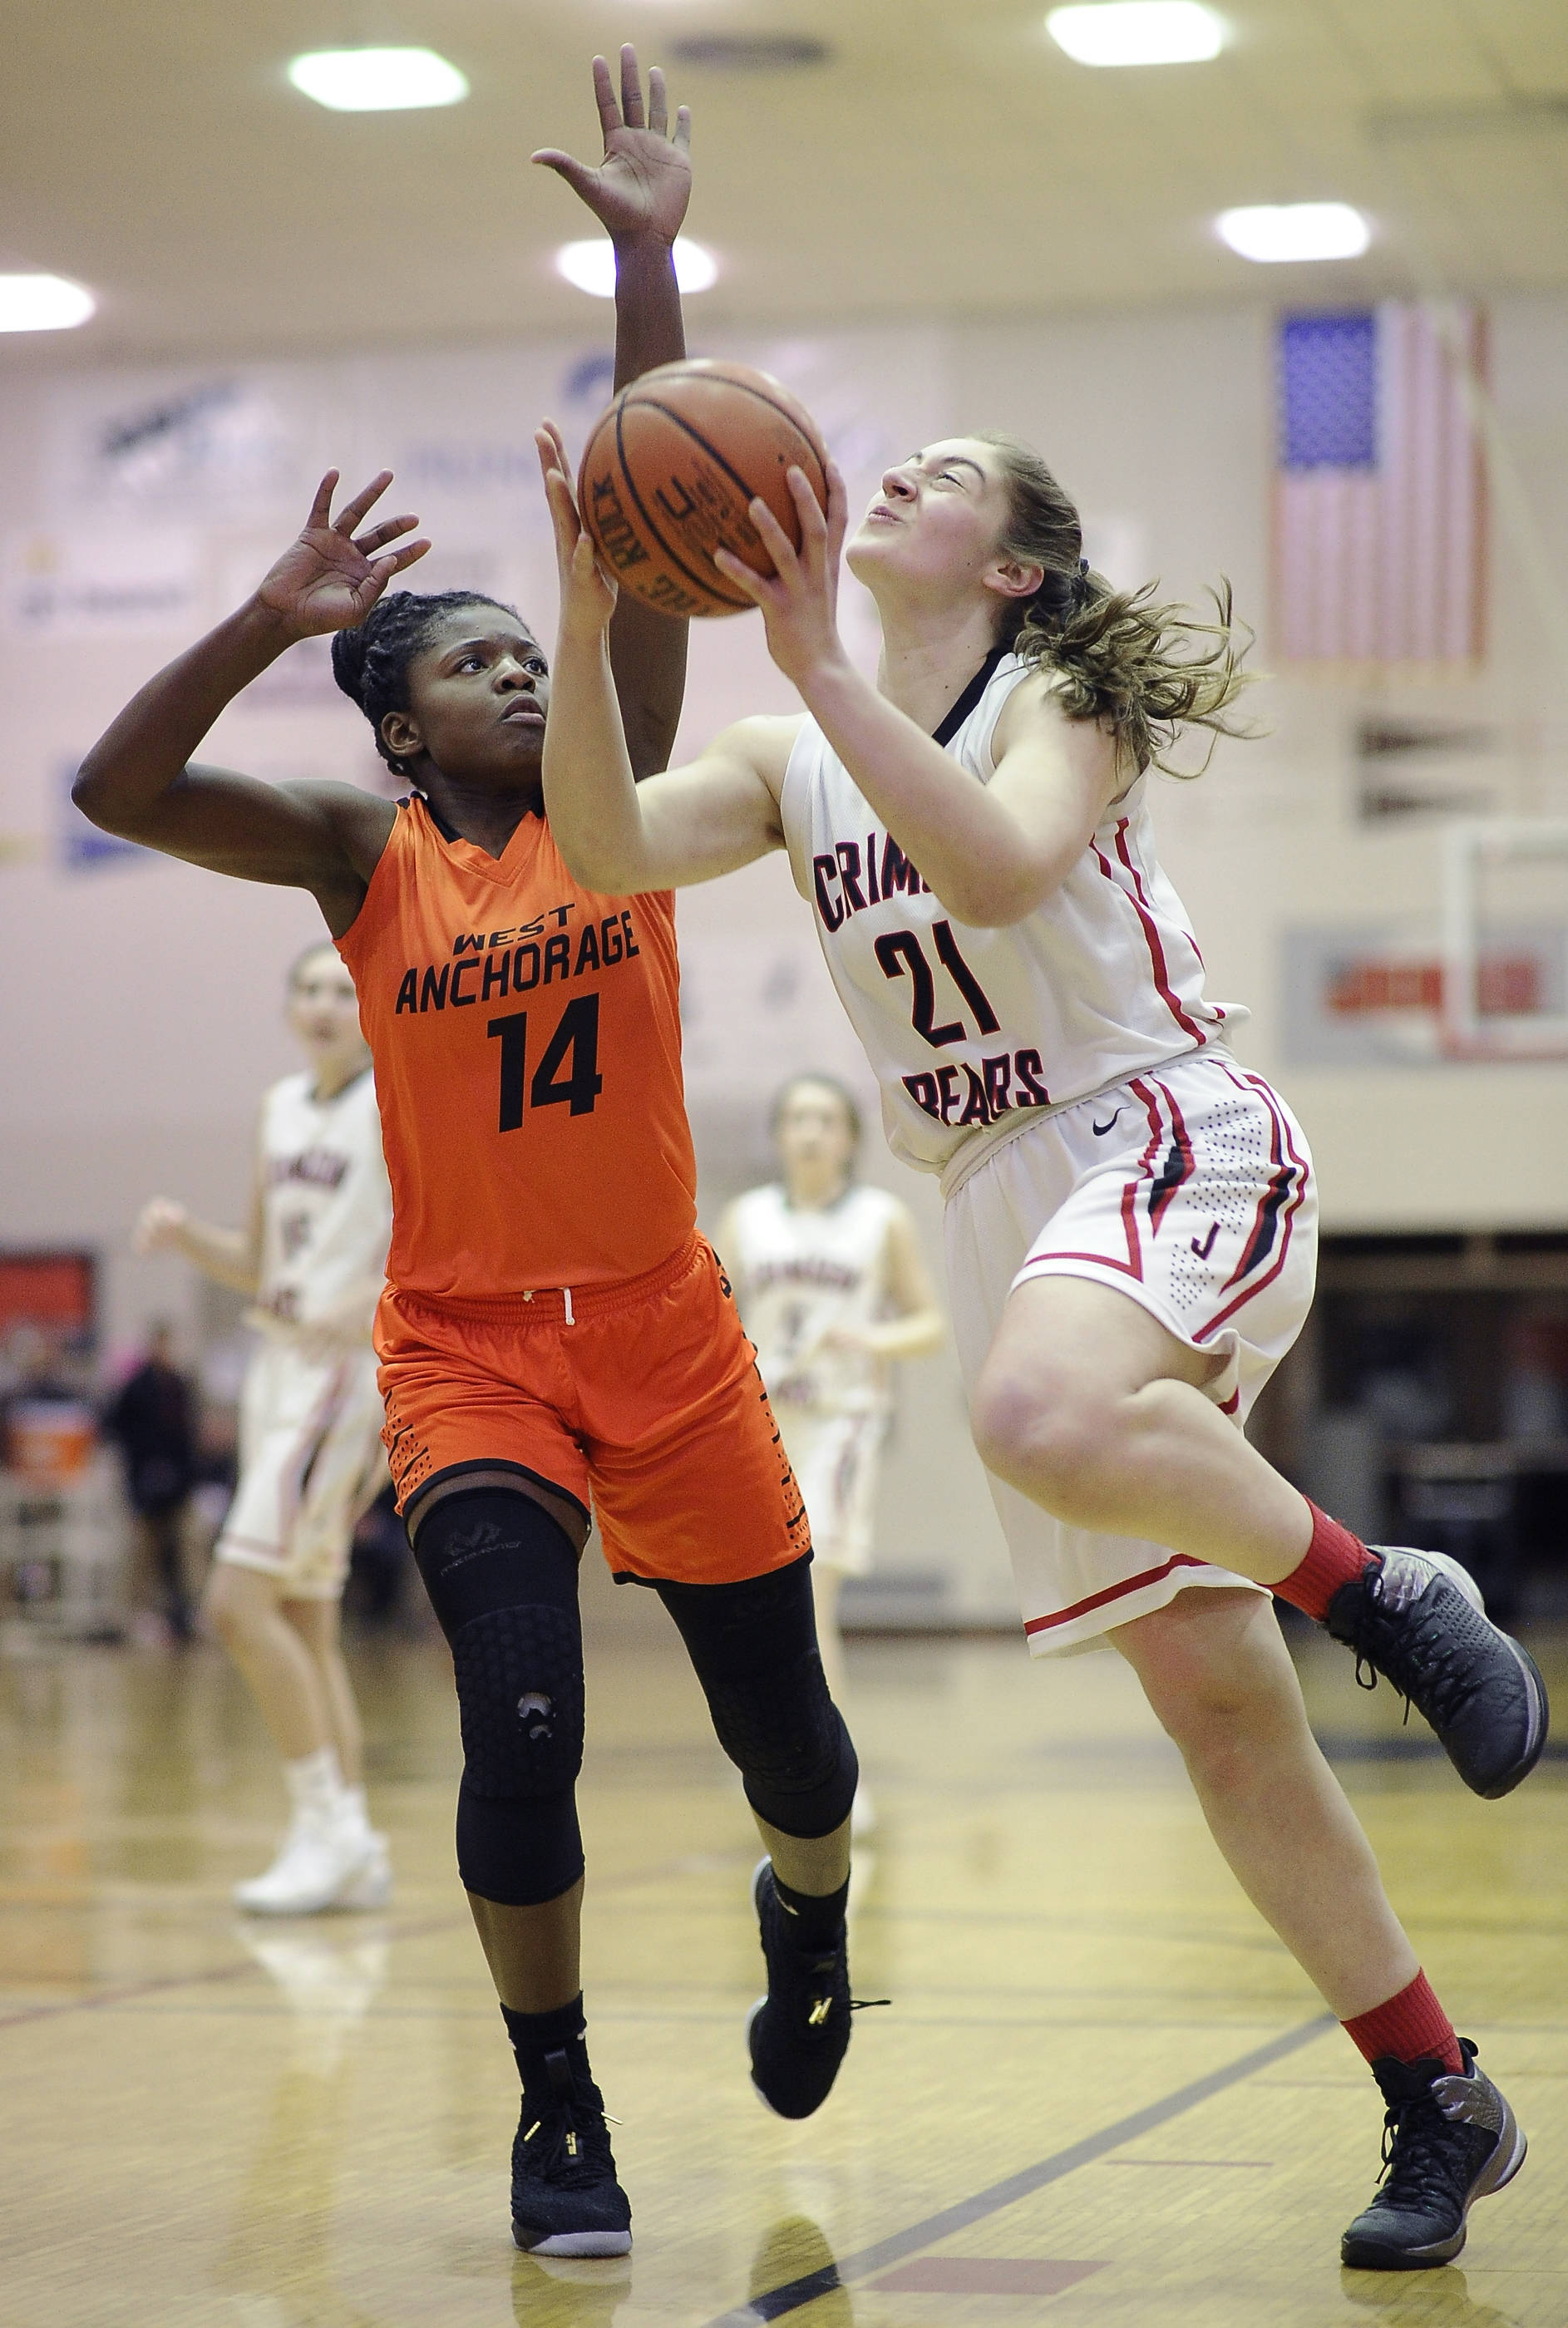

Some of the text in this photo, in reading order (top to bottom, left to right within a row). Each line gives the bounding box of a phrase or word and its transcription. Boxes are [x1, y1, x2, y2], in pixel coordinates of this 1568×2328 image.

[452, 903, 575, 956] WEST
[813, 831, 933, 933] CRIM
[395, 910, 640, 1014] ANCHORAGE
[874, 920, 1001, 1048] 21
[486, 993, 603, 1133] 14
